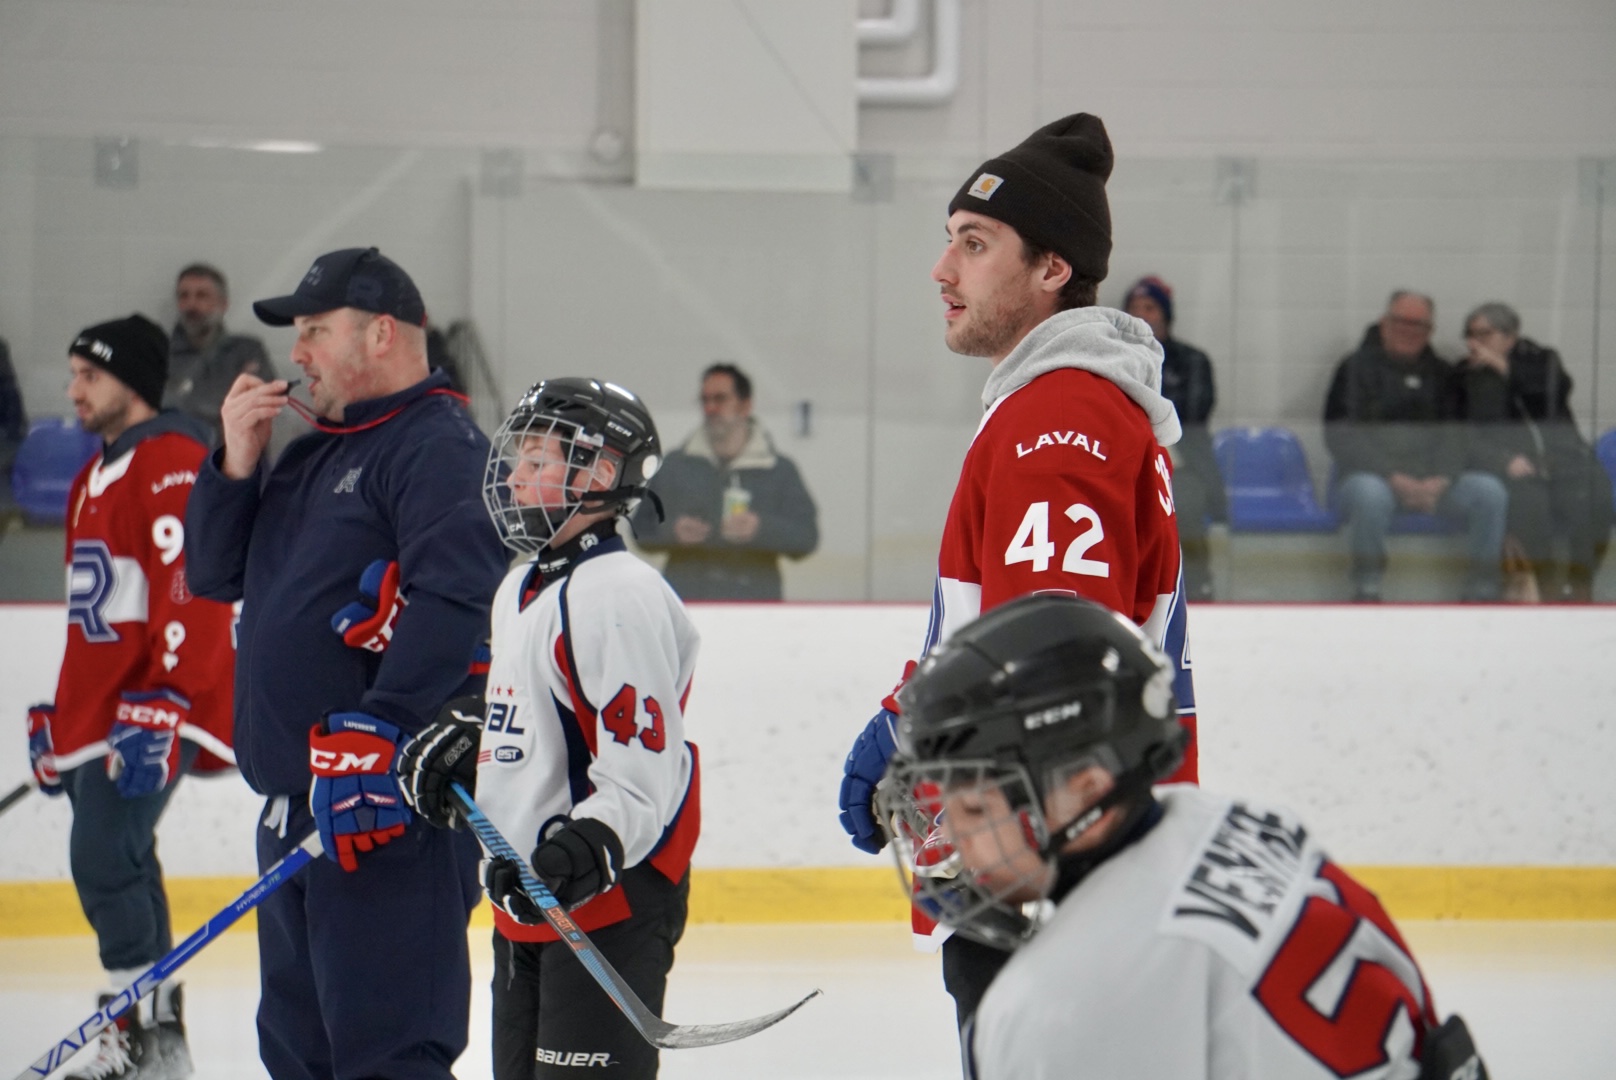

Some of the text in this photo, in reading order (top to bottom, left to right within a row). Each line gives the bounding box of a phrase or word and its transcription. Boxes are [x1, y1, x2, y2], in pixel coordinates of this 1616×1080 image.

[1016, 431, 1107, 461] LAVAL
[151, 469, 198, 495] LAVA
[1005, 501, 1109, 578] 42
[117, 703, 179, 727] CCM
[600, 682, 666, 754] 43
[1024, 701, 1082, 730] CCM
[547, 906, 577, 934] COVERT
[30, 971, 158, 1077] VAPOR
